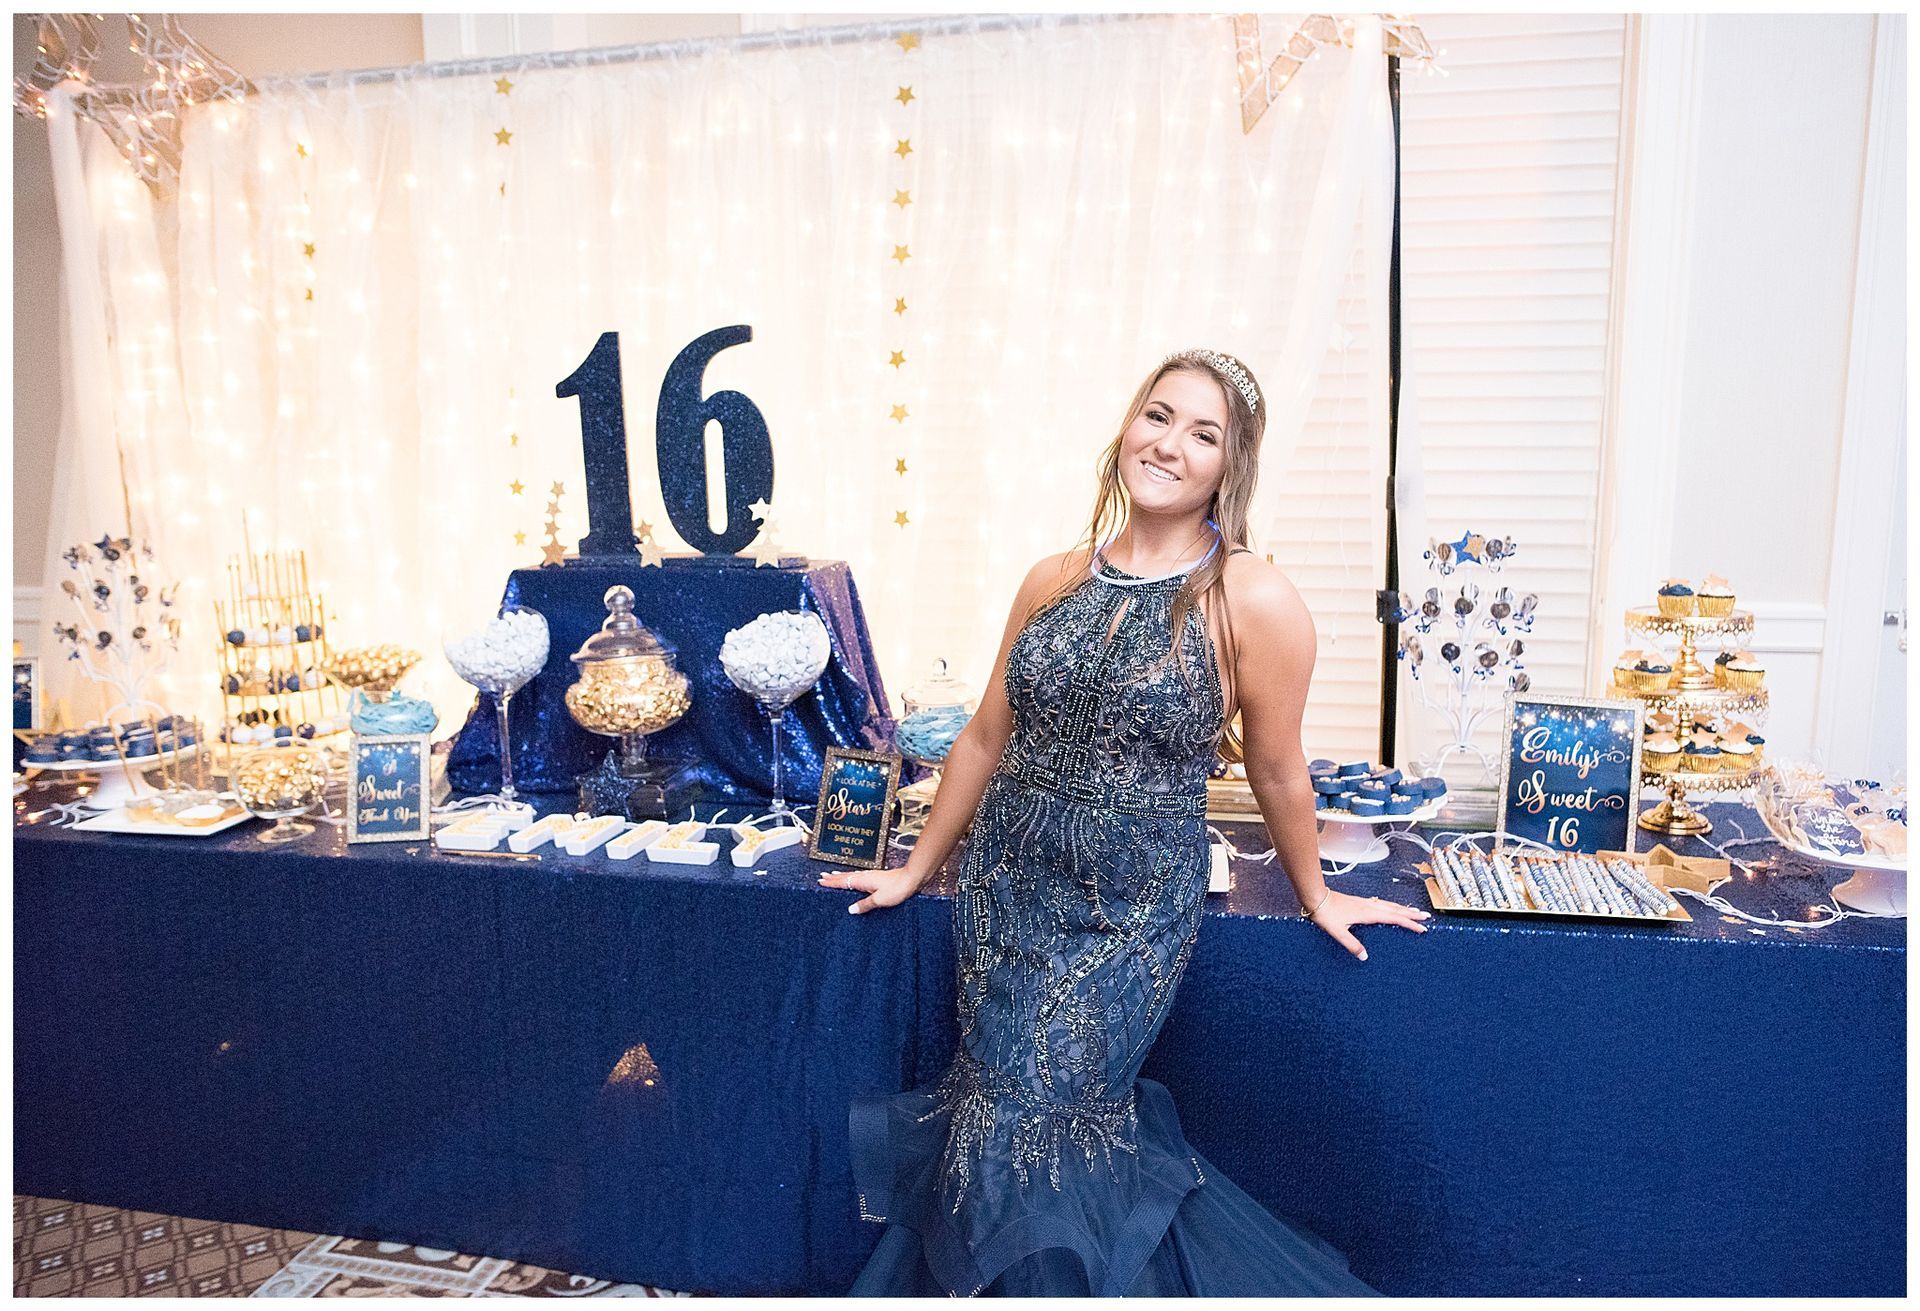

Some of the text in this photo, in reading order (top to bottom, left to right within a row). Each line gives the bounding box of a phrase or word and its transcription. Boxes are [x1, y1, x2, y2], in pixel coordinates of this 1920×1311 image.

[556, 324, 775, 556] 16
[1520, 726, 1625, 779] Emily's
[358, 774, 420, 803] Sweet
[840, 777, 857, 786] LOOK
[1516, 769, 1624, 814] Sweet
[825, 787, 883, 820] Stars
[435, 802, 801, 868] EMILY
[827, 823, 844, 832] LOOK
[844, 826, 860, 834] HOW
[833, 834, 864, 846] SHINE FOR
[1546, 815, 1580, 848] 16
[841, 847, 854, 856] YOU
